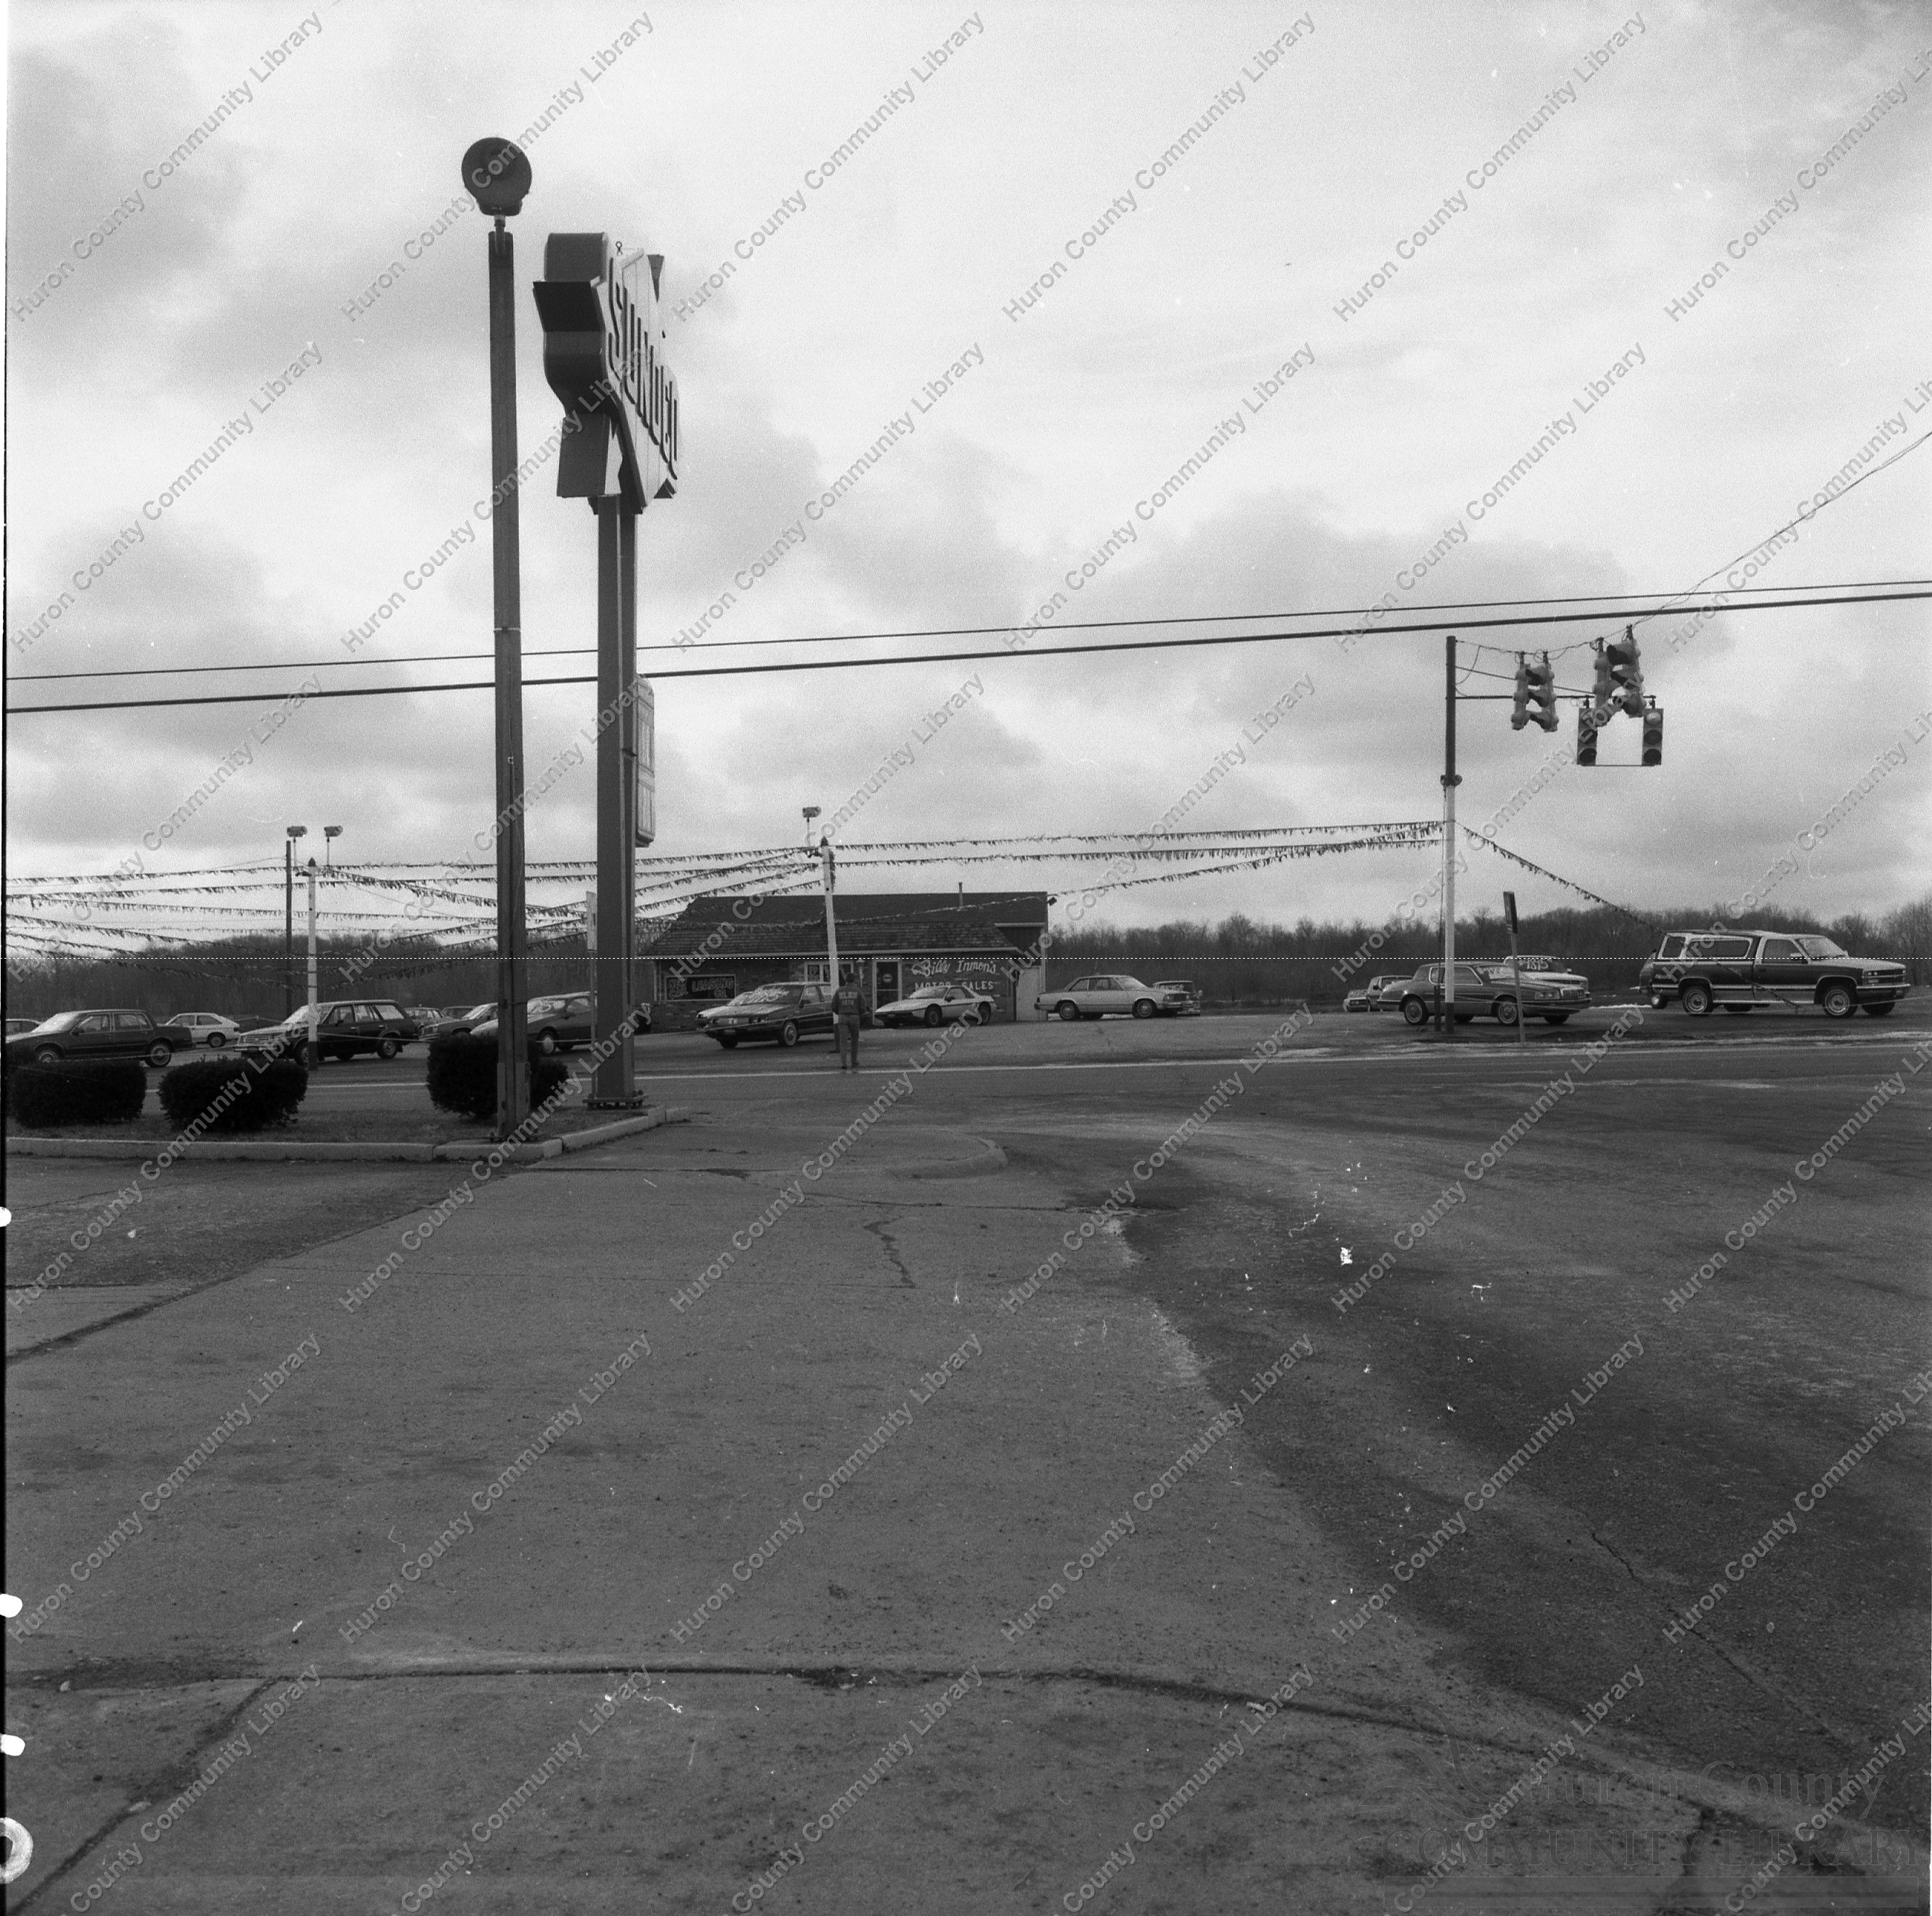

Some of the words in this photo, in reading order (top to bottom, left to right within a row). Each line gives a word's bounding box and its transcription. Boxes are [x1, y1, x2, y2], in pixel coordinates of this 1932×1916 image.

[606, 255, 679, 480] SUNOCO
[911, 959, 951, 977] Billy
[691, 977, 734, 993] LEASING
[962, 980, 994, 990] SALES
